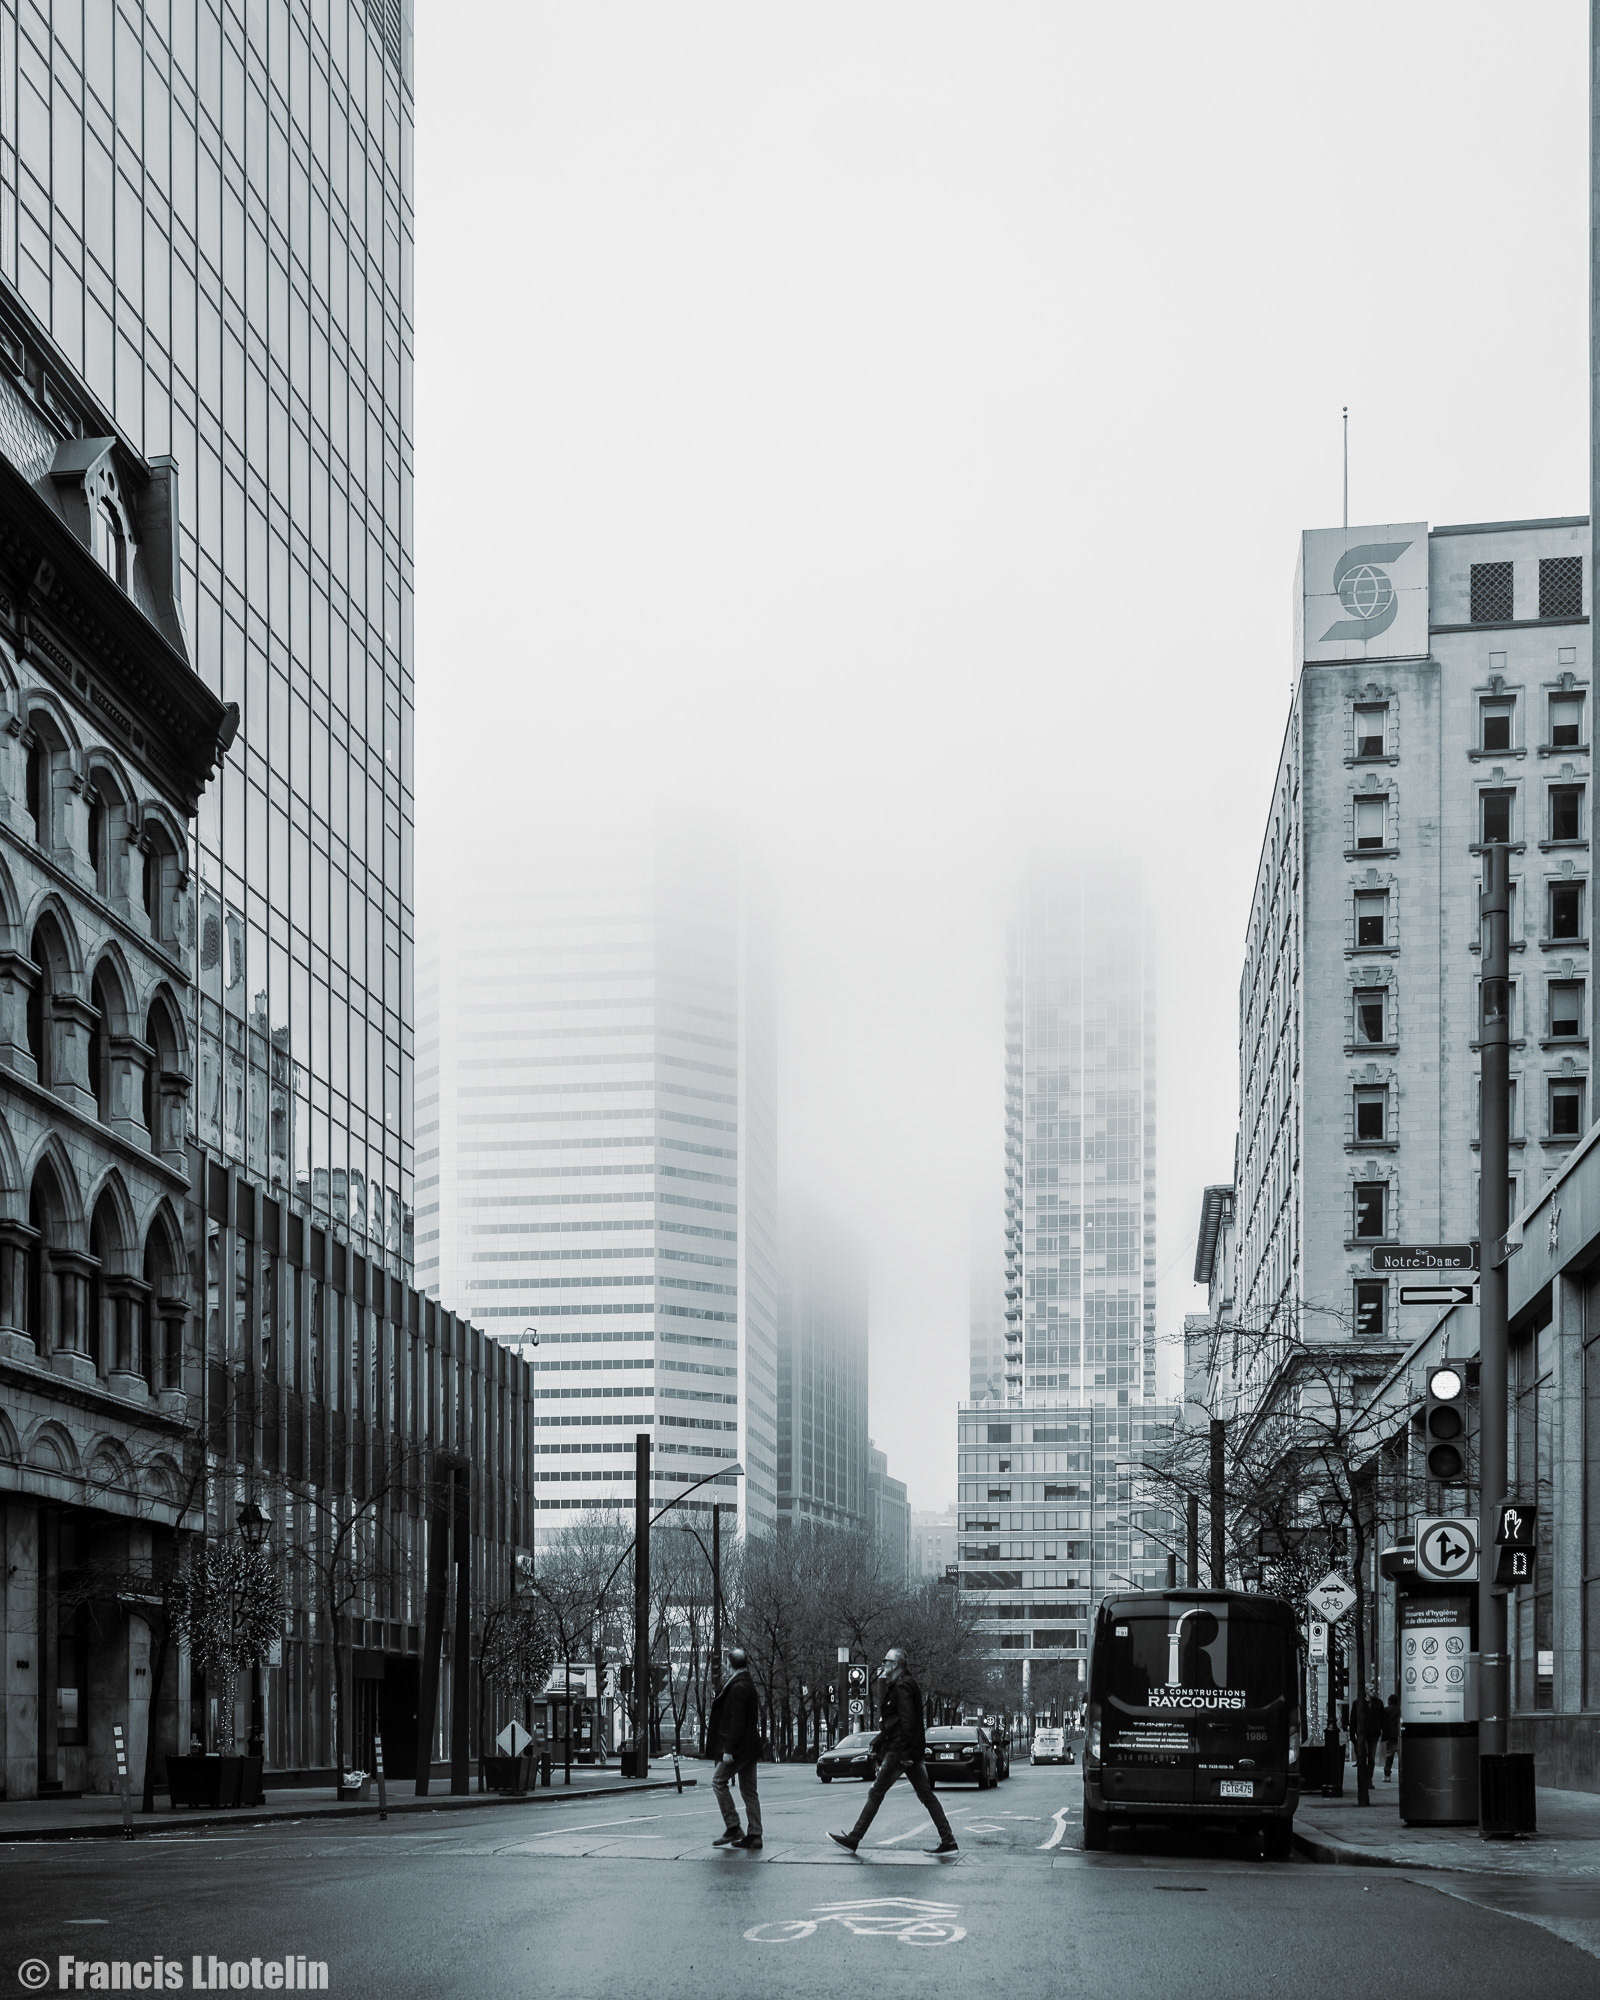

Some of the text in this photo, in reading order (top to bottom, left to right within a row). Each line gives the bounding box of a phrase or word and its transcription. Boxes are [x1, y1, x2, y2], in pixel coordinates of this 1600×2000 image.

[1384, 1255, 1461, 1268] Notre-Dame
[1402, 1557, 1415, 1565] Rue
[1425, 1608, 1458, 1617] d'hygiène
[1416, 1616, 1457, 1624] distanciation
[1169, 1688, 1246, 1697] CONSTRUCTIONS
[1148, 1696, 1242, 1709] RAYCOURS
[1245, 1732, 1268, 1741] 1986
[1137, 1754, 1181, 1762] 894-9171
